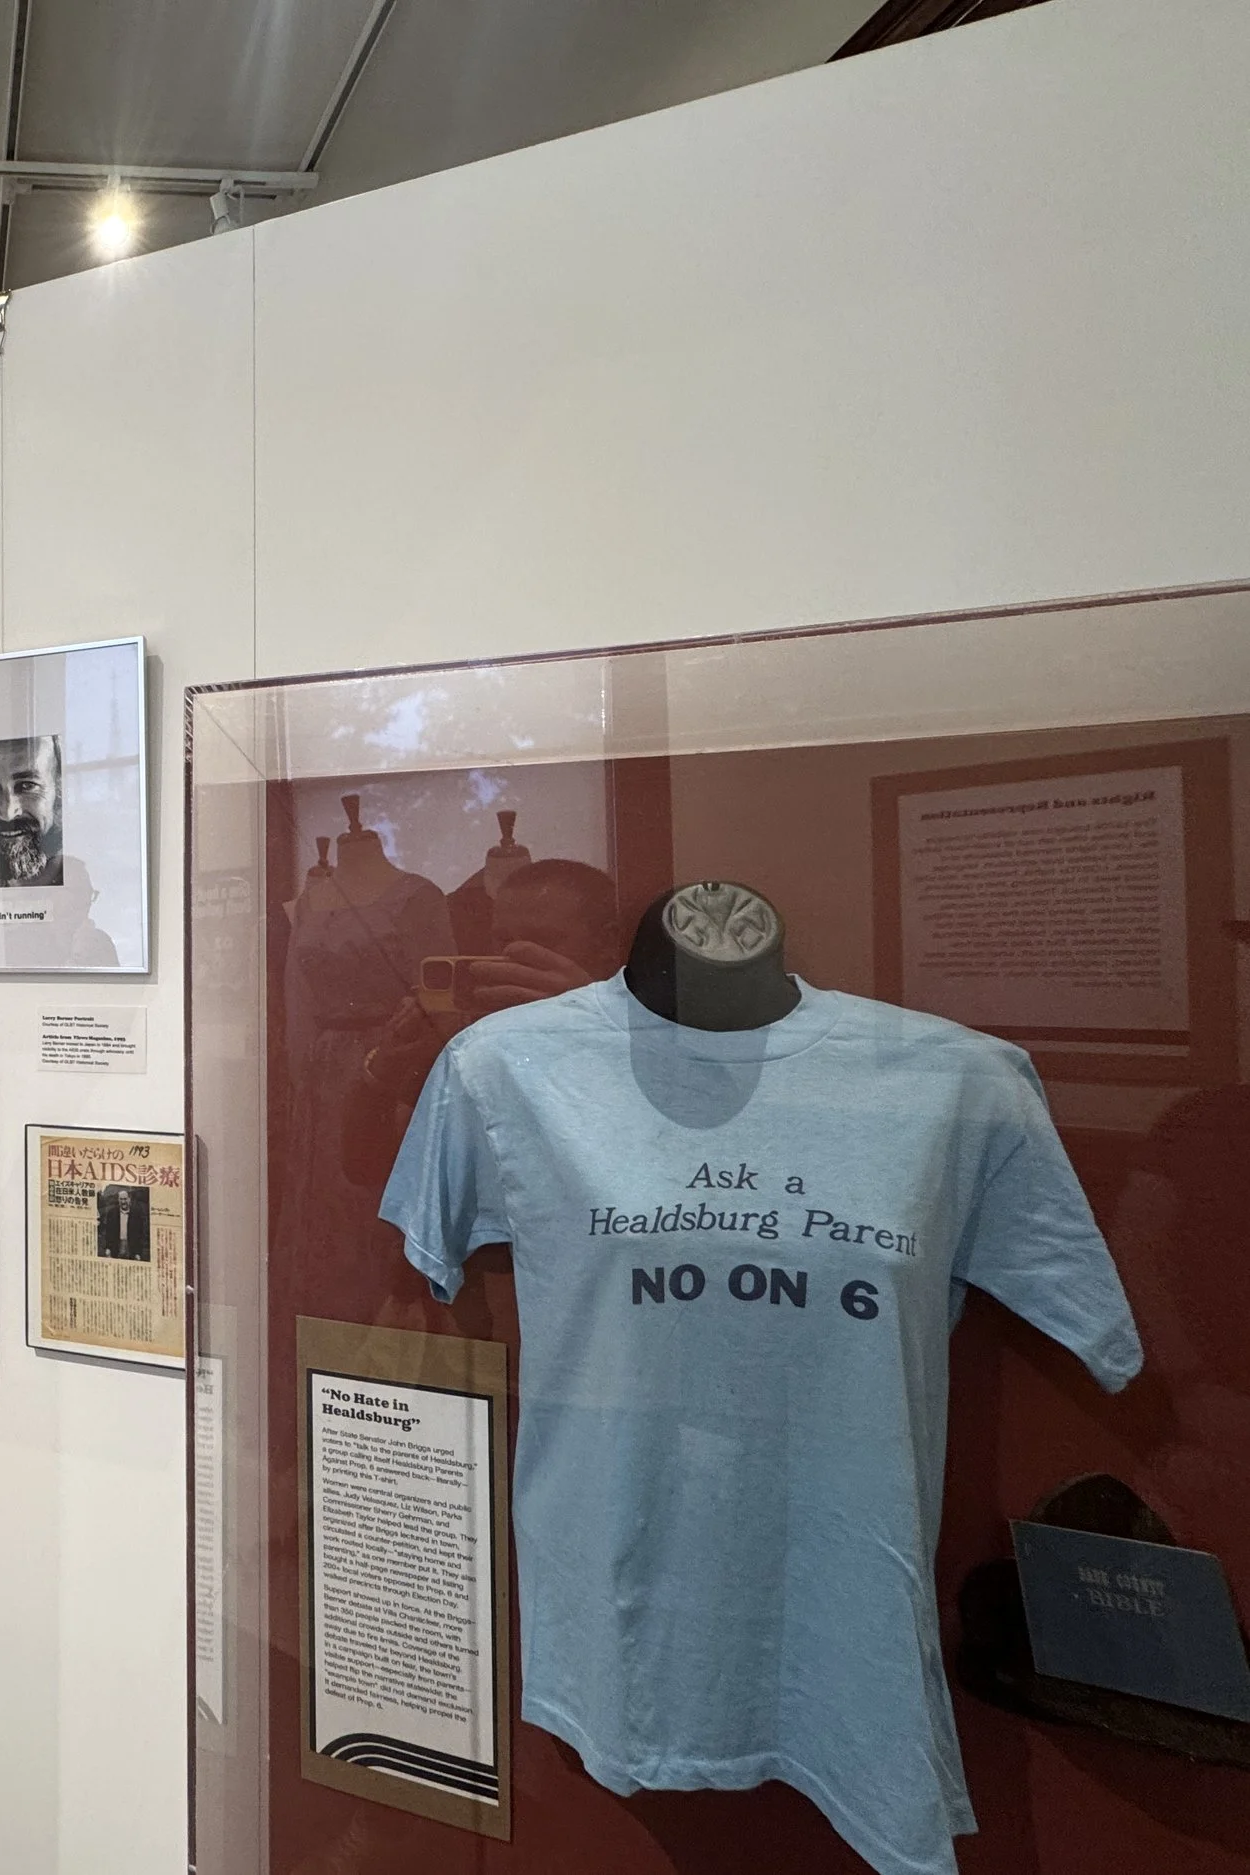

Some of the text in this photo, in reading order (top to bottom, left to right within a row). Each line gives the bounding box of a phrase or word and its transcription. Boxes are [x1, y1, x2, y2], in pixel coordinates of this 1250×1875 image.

[129, 1145, 150, 1159] 1993
[686, 1162, 806, 1195] Ask a
[589, 1202, 918, 1257] Healdsburg Parent
[632, 1263, 880, 1320] NO ON 6
[321, 1387, 410, 1413] “No Hate in
[322, 1403, 421, 1432] Healdsburg”
